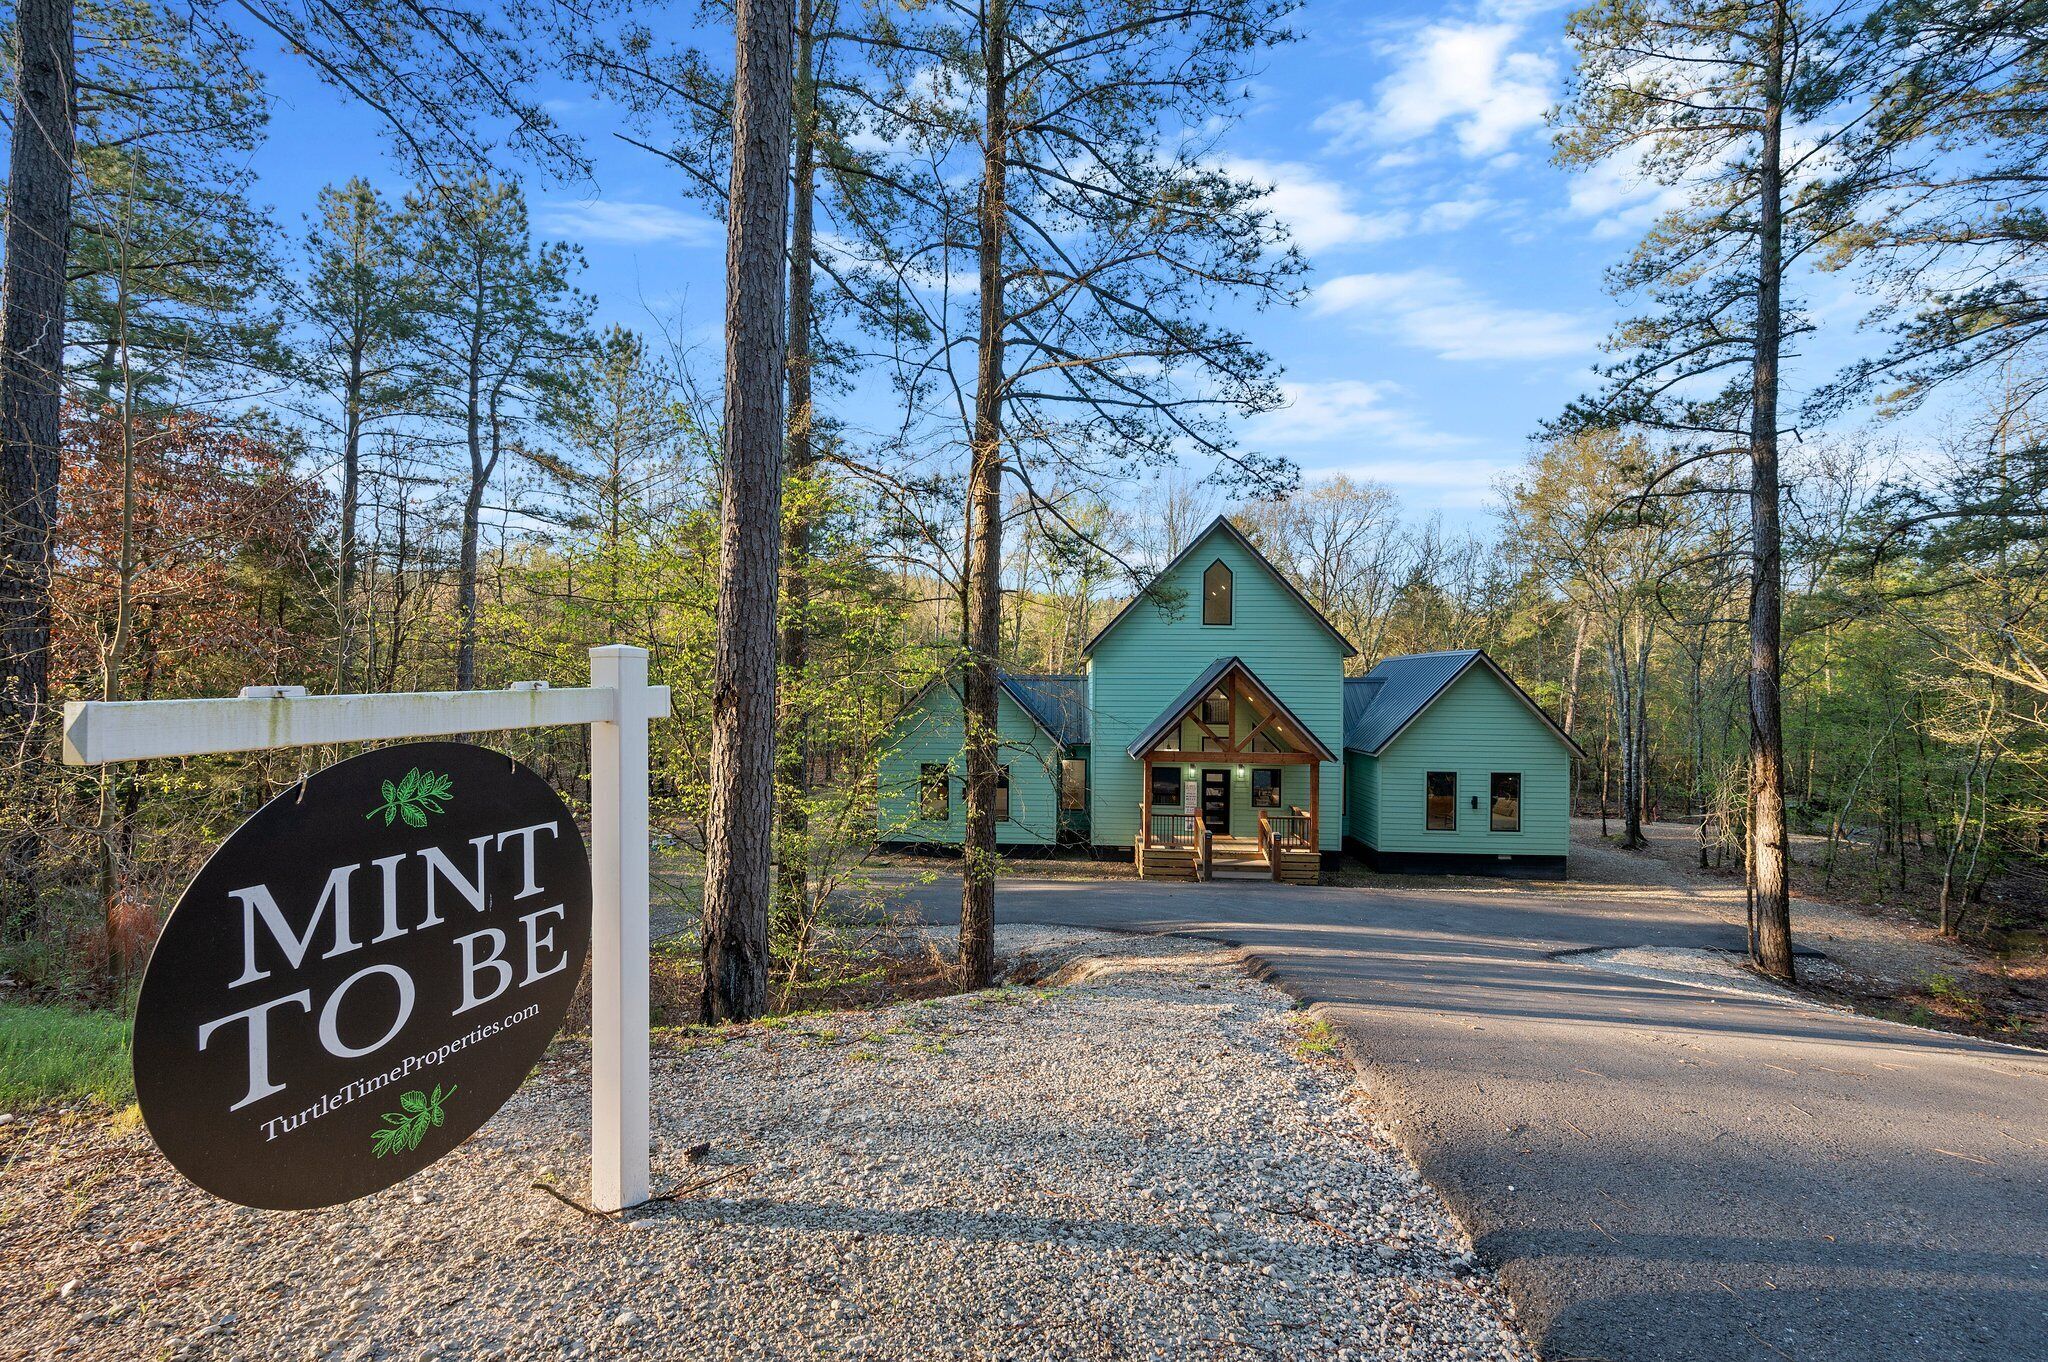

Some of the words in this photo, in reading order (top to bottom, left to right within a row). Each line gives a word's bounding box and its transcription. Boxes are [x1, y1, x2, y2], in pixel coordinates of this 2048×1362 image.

[228, 821, 559, 989] MINT
[198, 964, 416, 1113] TO
[451, 903, 568, 1017] BE
[260, 1003, 540, 1142] TurtleTimeProperties.com
